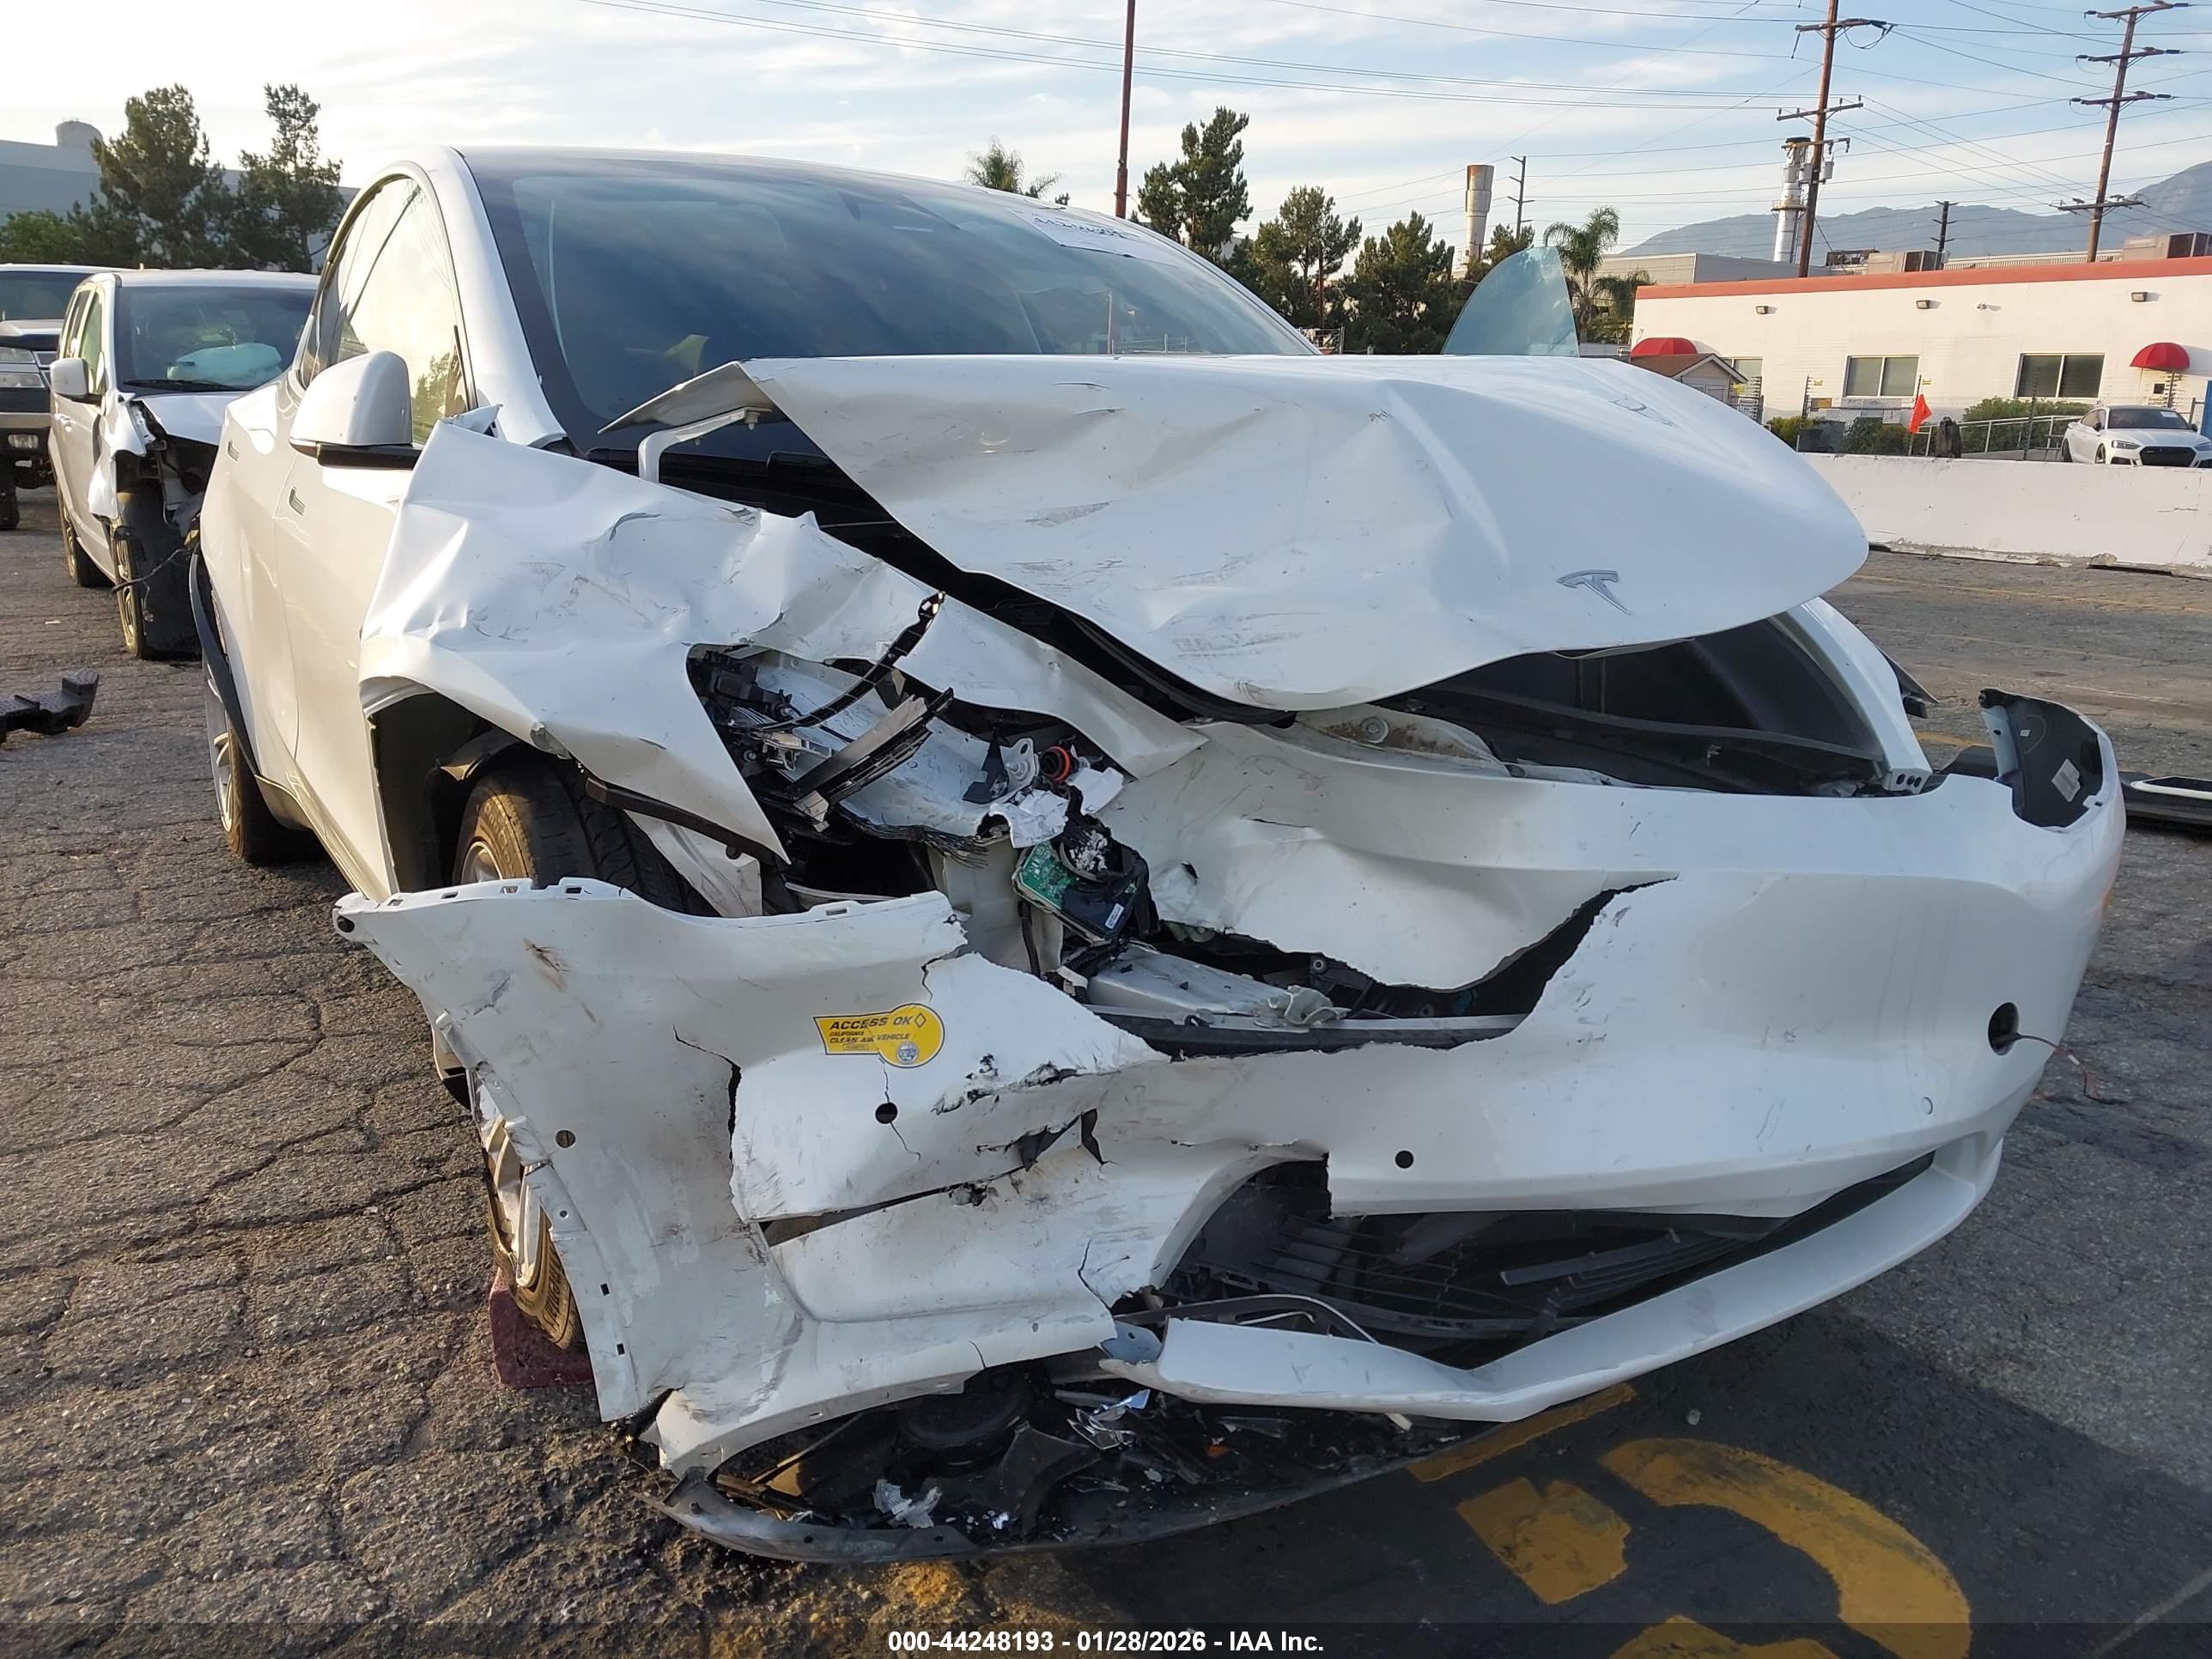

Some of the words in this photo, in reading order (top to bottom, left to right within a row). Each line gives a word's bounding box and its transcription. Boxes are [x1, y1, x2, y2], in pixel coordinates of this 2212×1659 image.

[830, 1018, 888, 1030] ACCESS
[893, 1016, 913, 1026] OK
[878, 1032, 911, 1041] VEHICLE
